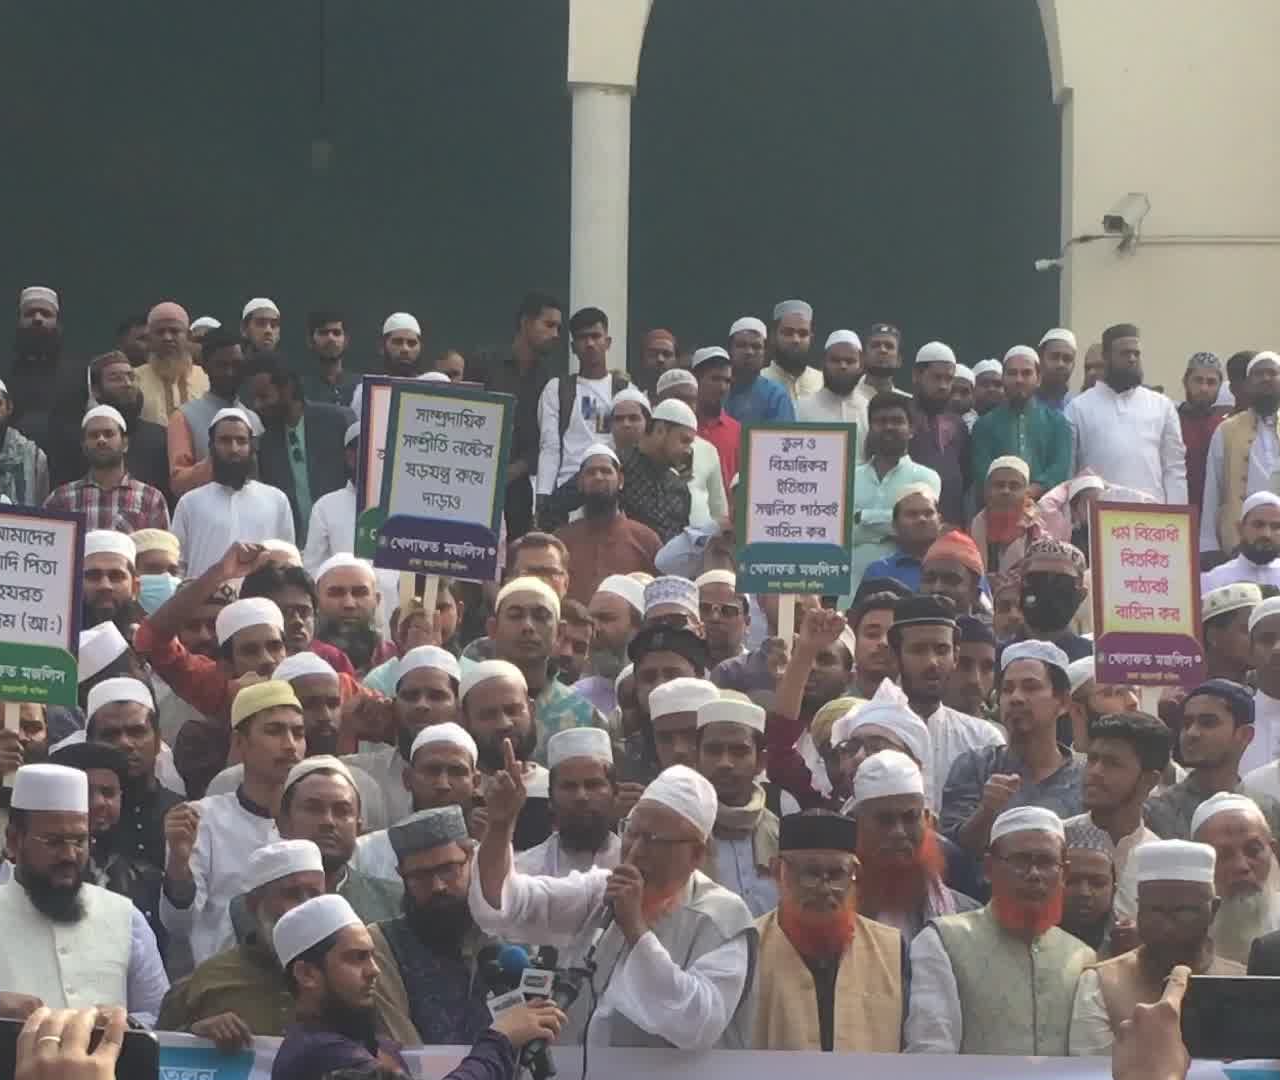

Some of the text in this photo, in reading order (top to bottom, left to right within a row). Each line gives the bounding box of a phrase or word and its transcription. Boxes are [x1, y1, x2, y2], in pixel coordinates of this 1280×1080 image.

[806, 438, 817, 450] ও
[764, 522, 827, 539] বাতিল কর
[23, 553, 58, 576] পিতা
[1114, 602, 1180, 622] বাতিল কর
[22, 664, 66, 685] মজলিস
